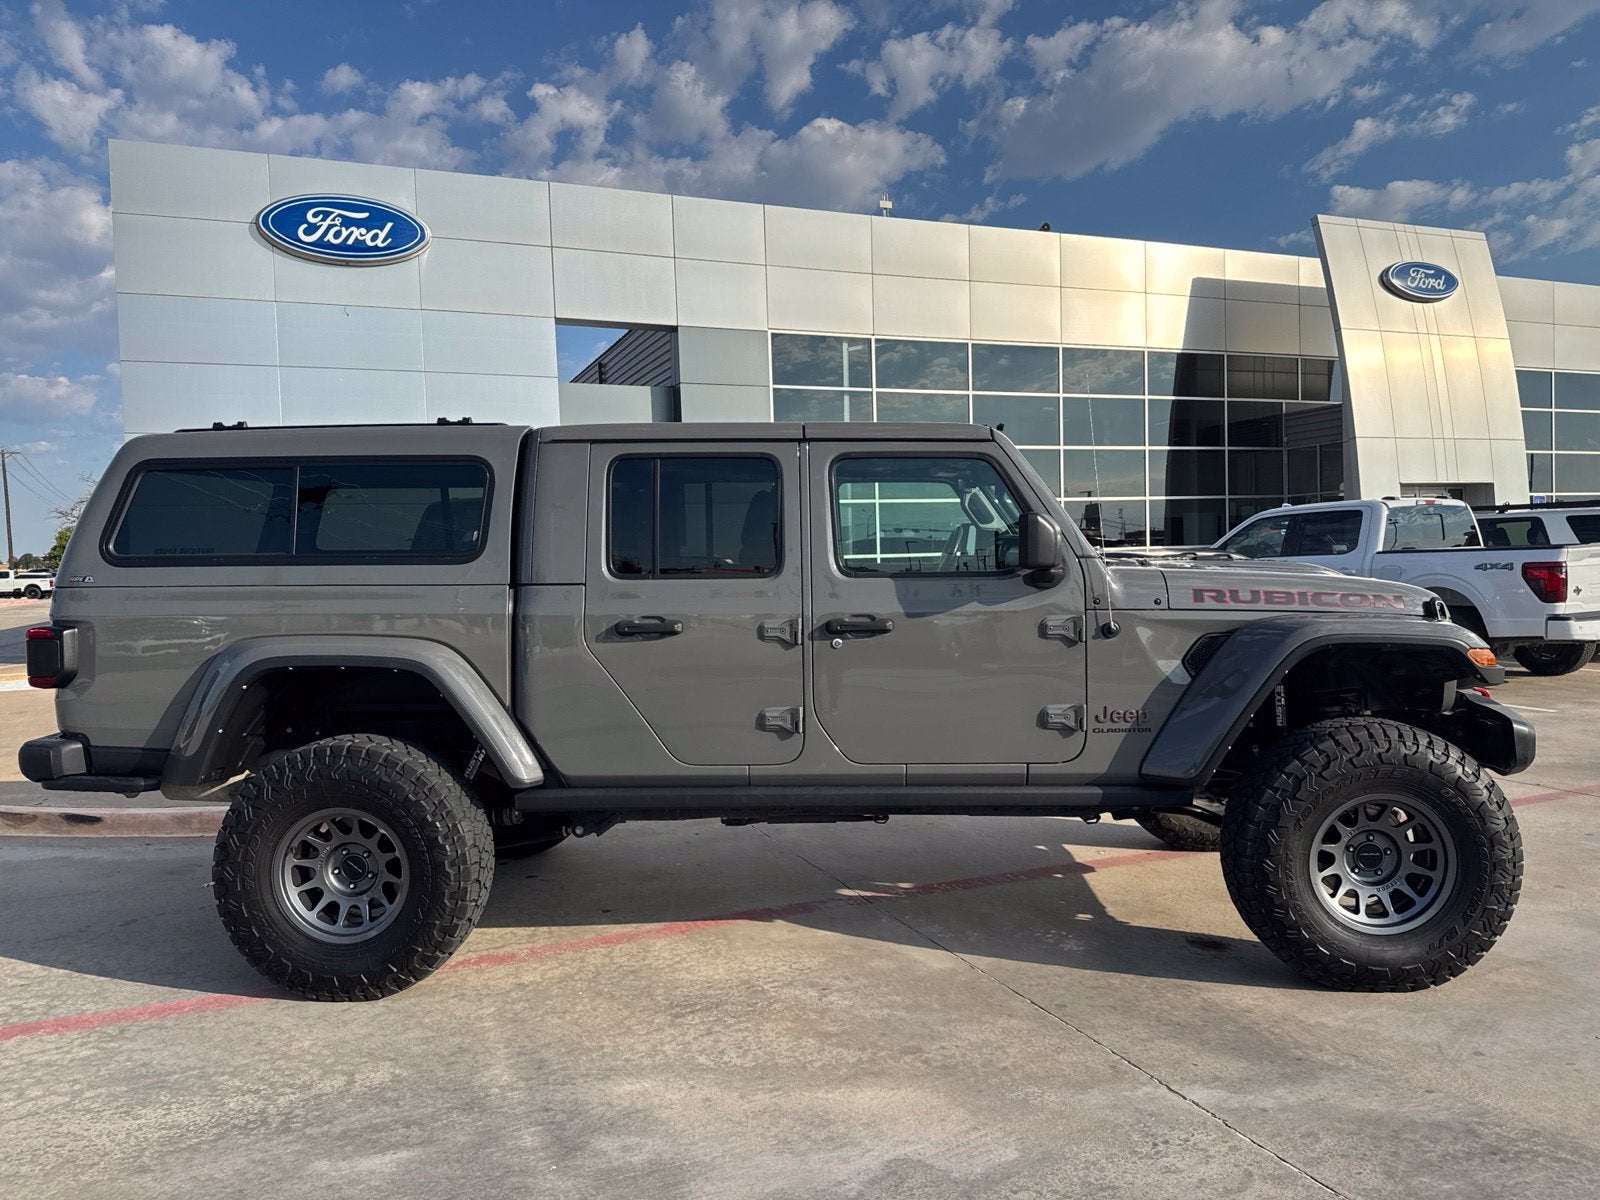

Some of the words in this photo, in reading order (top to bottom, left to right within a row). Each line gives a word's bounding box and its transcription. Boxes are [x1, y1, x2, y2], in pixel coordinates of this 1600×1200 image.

[297, 206, 394, 248] Ford
[1407, 267, 1446, 290] Ford
[1191, 588, 1406, 609] RUBICON
[1095, 705, 1148, 726] Jeep
